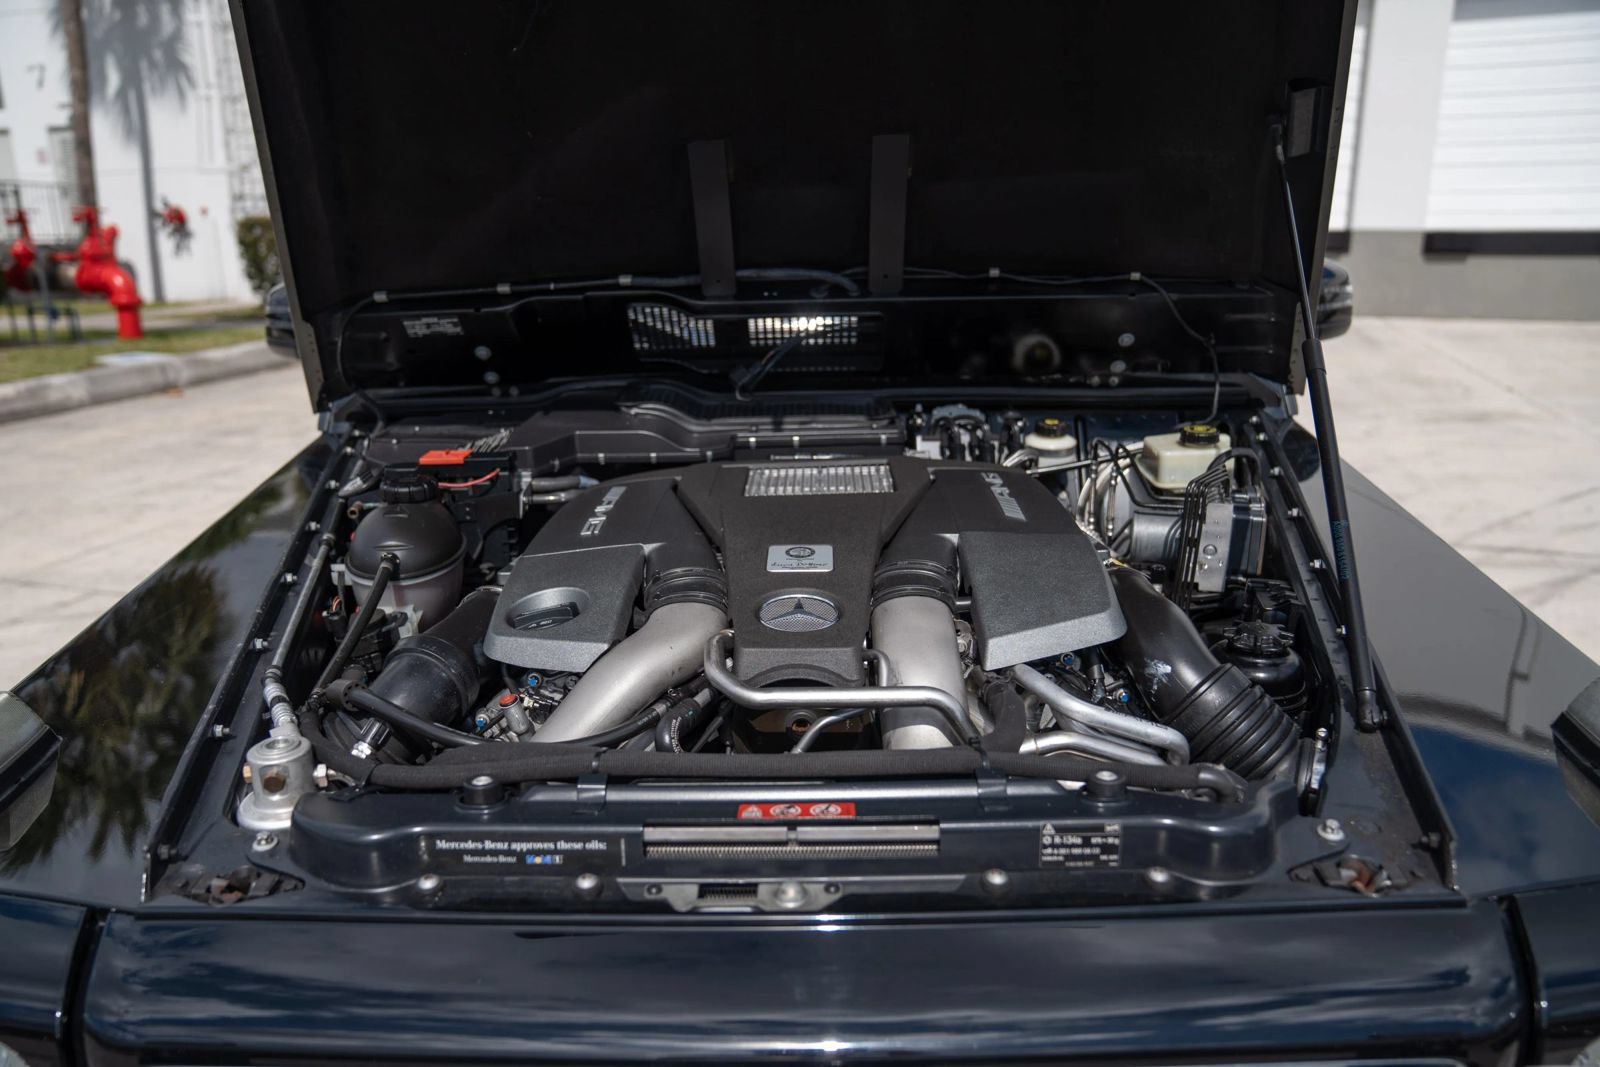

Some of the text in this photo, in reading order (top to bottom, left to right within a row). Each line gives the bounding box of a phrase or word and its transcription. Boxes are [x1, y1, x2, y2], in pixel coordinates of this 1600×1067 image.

[580, 497, 619, 535] AMG
[435, 839, 607, 852] Mercedes-Benz approves these oils:
[463, 854, 517, 863] Mercedes-Benz
